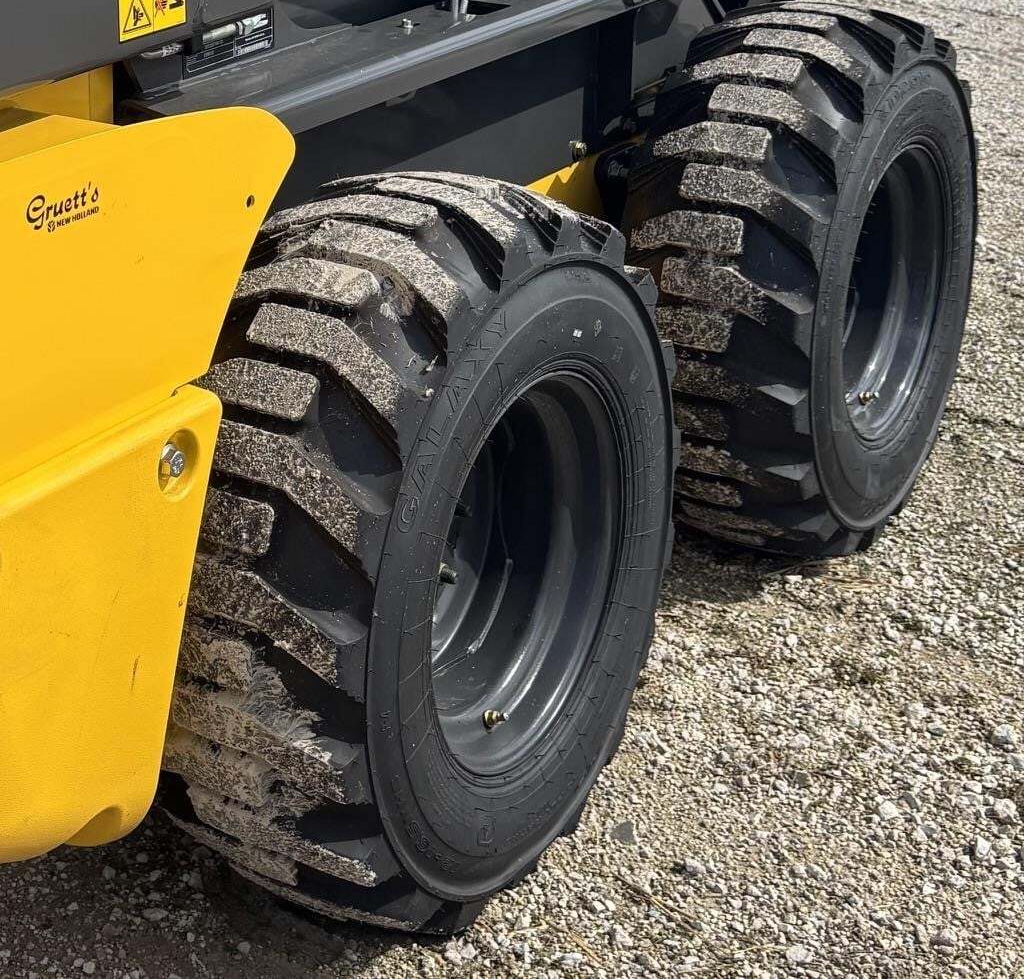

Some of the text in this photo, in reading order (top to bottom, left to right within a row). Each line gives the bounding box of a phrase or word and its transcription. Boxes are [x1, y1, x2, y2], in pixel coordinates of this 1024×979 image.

[26, 181, 99, 230] Gruett's
[56, 206, 100, 228] NEW HOLLAND
